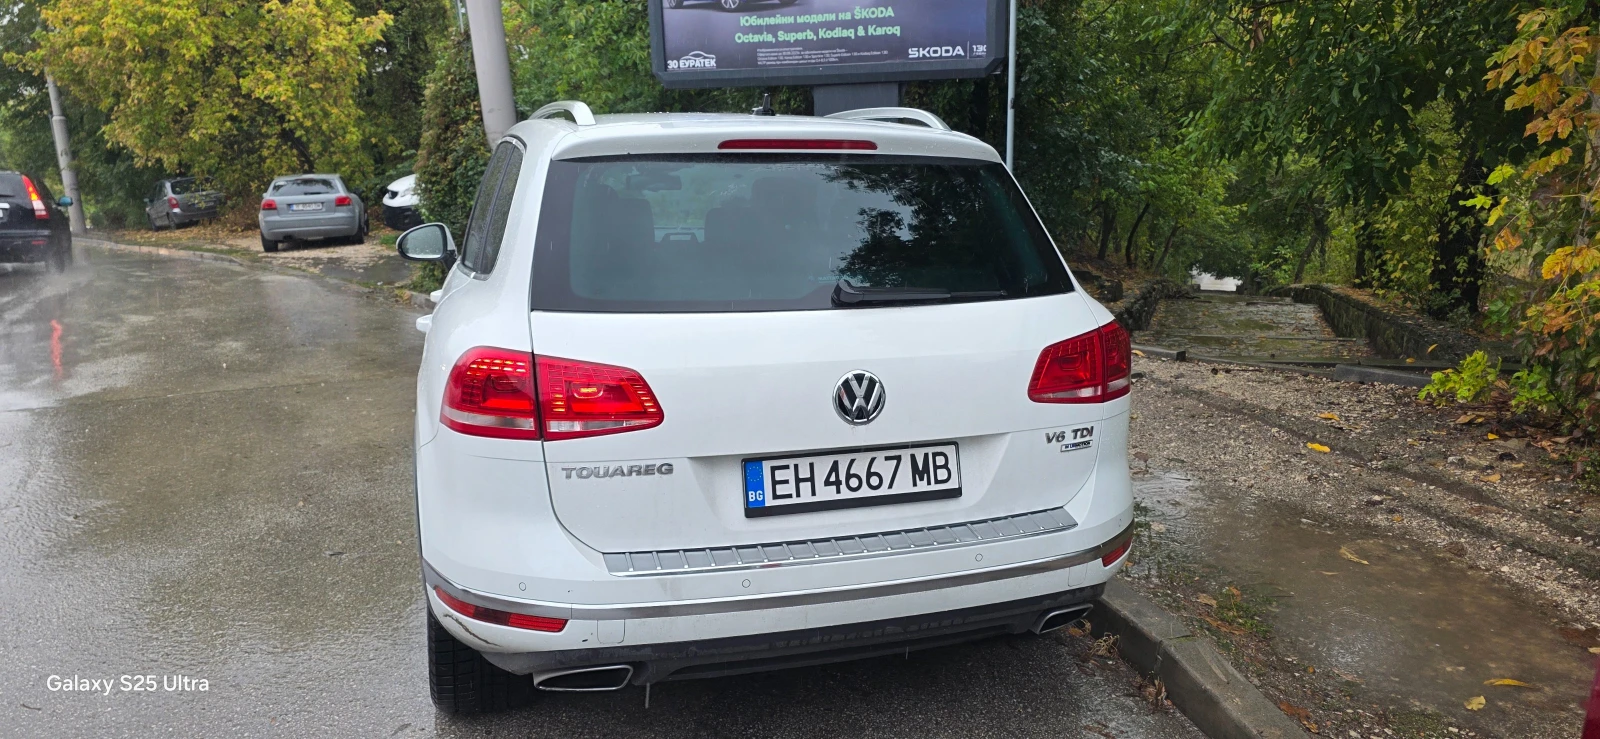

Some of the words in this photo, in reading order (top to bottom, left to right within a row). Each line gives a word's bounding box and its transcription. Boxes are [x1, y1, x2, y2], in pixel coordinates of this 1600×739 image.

[740, 14, 794, 27] Юбилейни
[797, 12, 836, 25] модели
[838, 11, 851, 21] на
[854, 6, 895, 20] ŠKODA
[735, 32, 775, 43] Octavia,
[778, 29, 816, 43] Superb,
[818, 26, 855, 39] Kodiaq
[857, 25, 865, 37] &
[868, 24, 901, 37] Karoq
[667, 60, 678, 69] 30
[1045, 430, 1066, 444] V6
[1071, 425, 1094, 440] TDI
[561, 462, 674, 480] TOUAREG
[770, 461, 817, 501] EH
[823, 454, 902, 493] 4667
[909, 451, 952, 488] MB
[748, 490, 764, 502] BG
